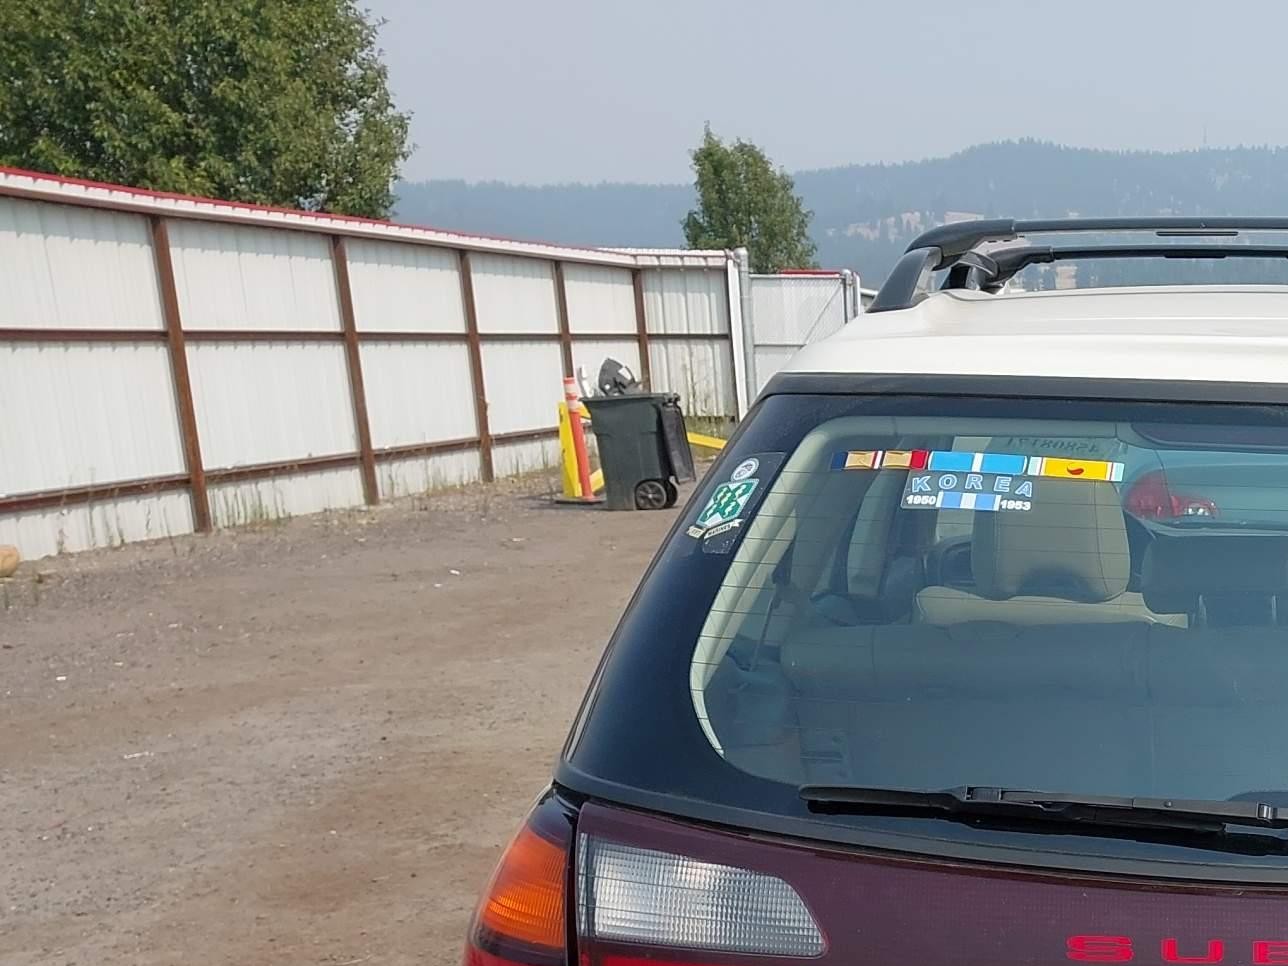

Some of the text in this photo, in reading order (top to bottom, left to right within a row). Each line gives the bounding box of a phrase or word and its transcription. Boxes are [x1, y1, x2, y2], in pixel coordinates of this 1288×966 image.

[911, 474, 1033, 498] KOREA
[906, 494, 936, 505] 1950
[1000, 499, 1031, 510] 1953
